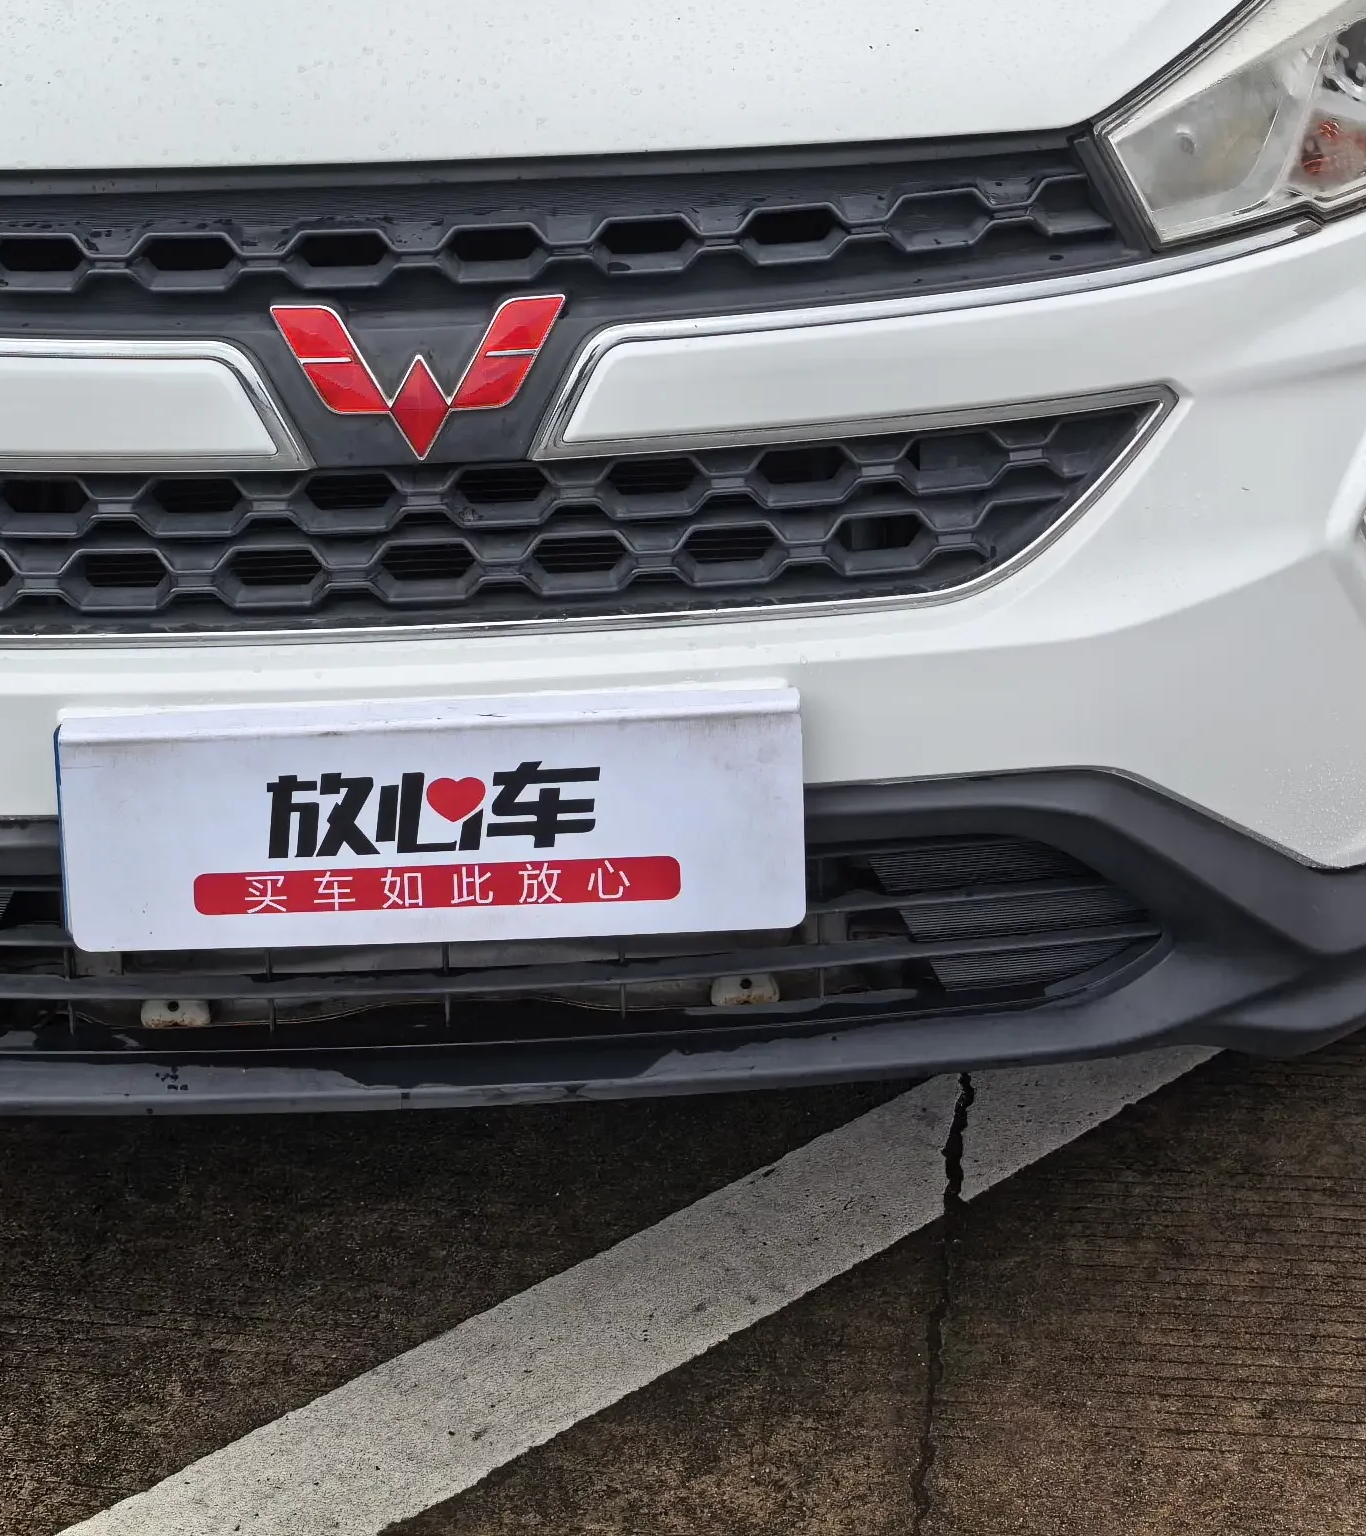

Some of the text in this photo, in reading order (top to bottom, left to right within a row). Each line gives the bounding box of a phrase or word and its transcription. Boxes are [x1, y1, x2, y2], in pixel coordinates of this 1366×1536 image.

[266, 760, 601, 858] 放心车
[244, 860, 631, 914] 买车如此放心
